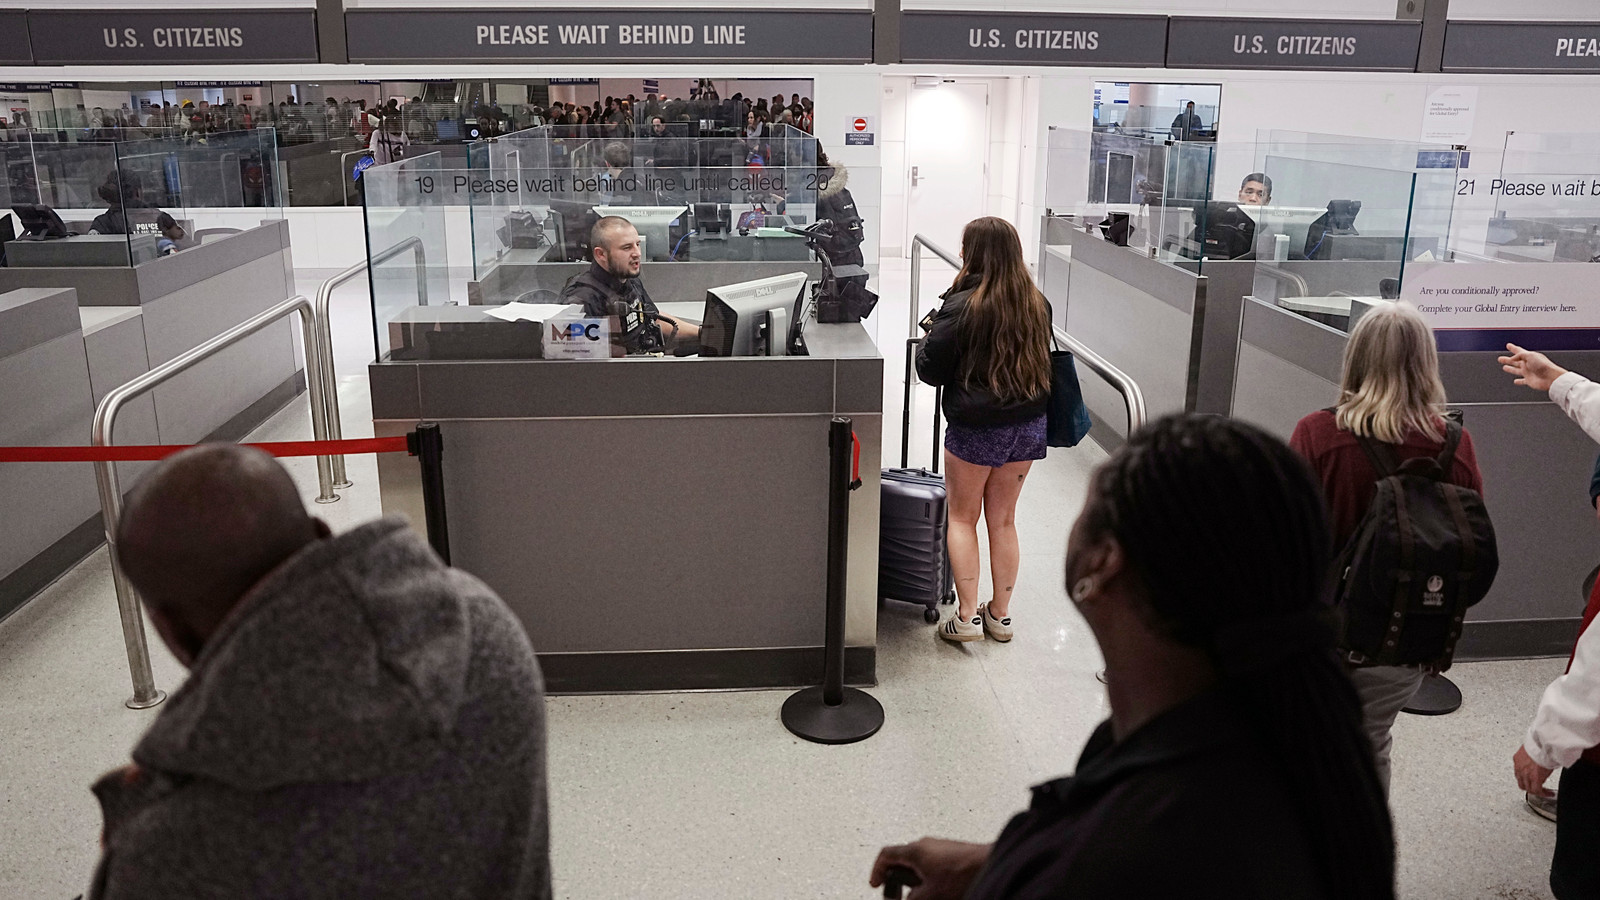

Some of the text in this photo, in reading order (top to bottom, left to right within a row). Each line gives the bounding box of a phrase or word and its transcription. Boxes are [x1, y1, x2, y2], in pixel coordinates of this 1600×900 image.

[103, 27, 244, 48] U.S. CITIZENS
[476, 25, 746, 45] PLEASE WAIT BEHIND LINE
[969, 28, 1099, 50] U.S. CITIZENS
[1233, 35, 1357, 55] U.S. CITIZENS
[1555, 38, 1600, 57] PLEA
[414, 173, 829, 194] 19 Please wait behind line until called. 20
[1457, 179, 1476, 196] 21
[1490, 179, 1546, 196] Please
[1551, 180, 1586, 196] wait
[1420, 286, 1540, 297] Are you conditionally approved?
[1418, 304, 1578, 315] Complete your Global Entry interview here.
[552, 324, 600, 341] MPC
